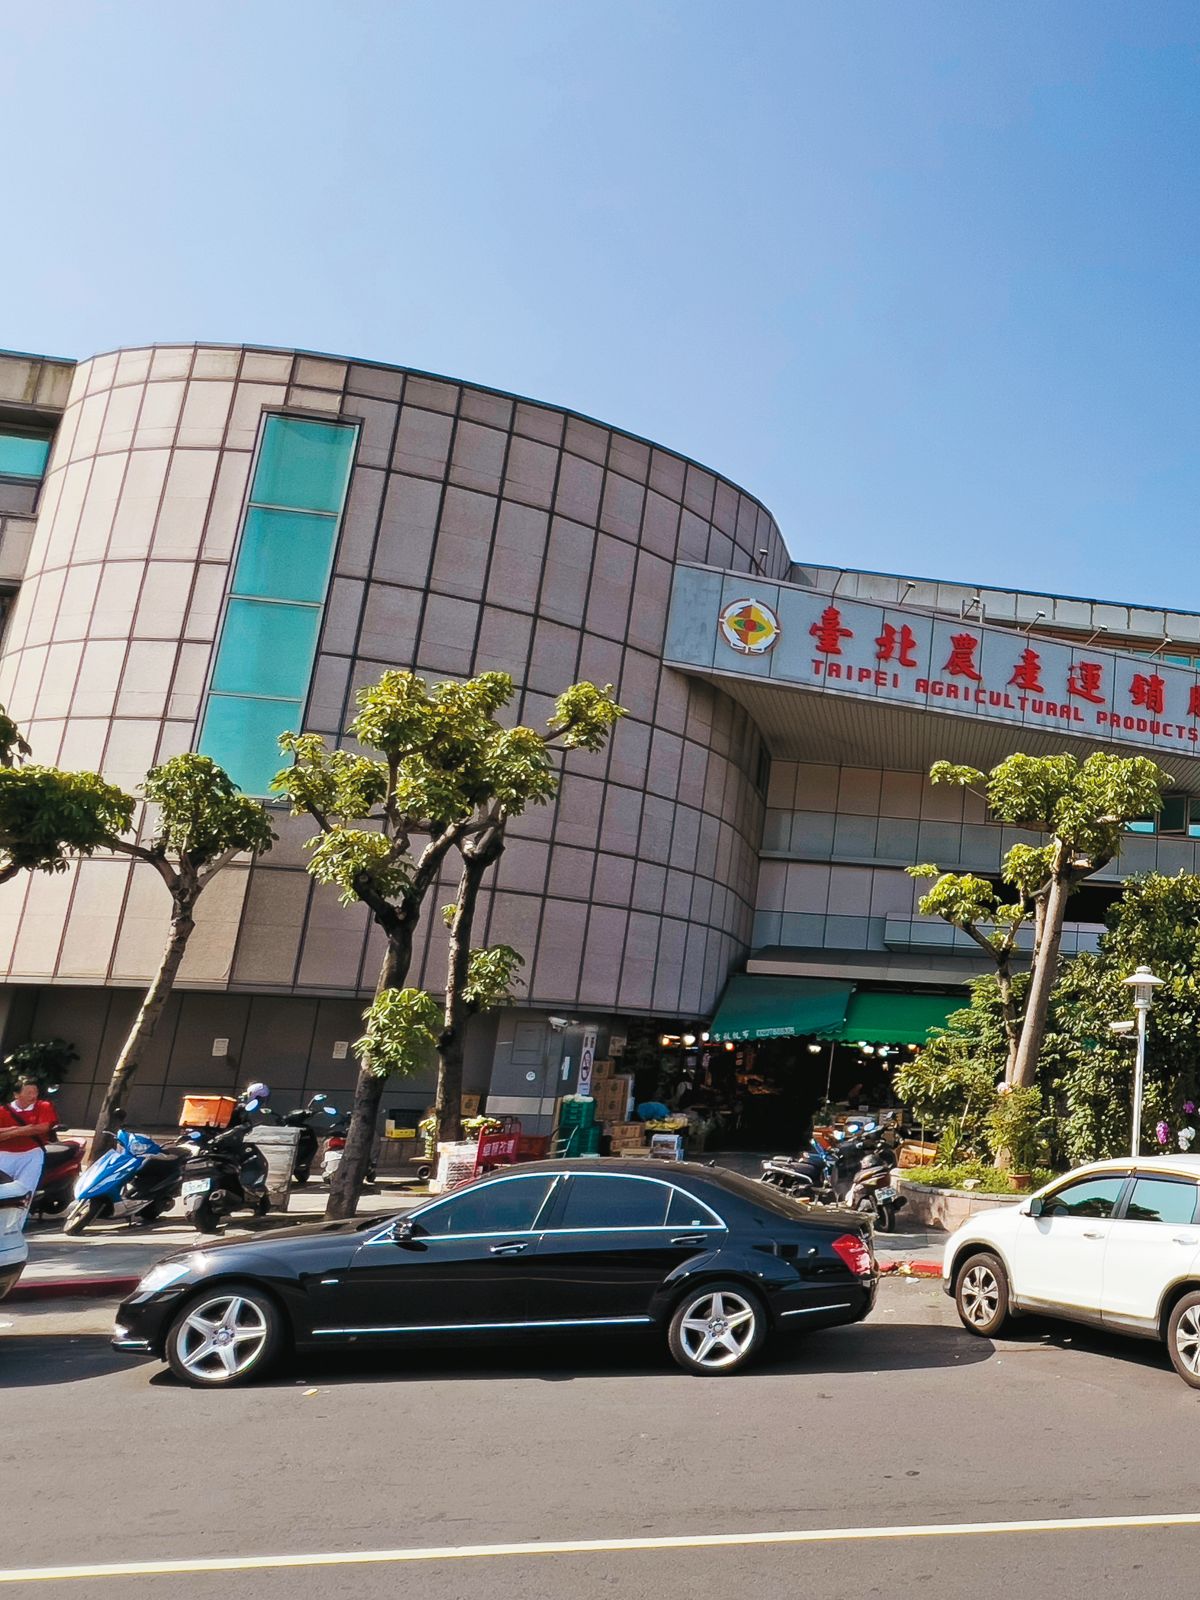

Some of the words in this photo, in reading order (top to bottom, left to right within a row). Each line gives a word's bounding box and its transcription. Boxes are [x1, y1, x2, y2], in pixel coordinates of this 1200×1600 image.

[811, 659, 899, 688] TAIPEI
[915, 678, 1085, 722] AGRICULTURAL
[1096, 710, 1198, 741] PRODUCTS
